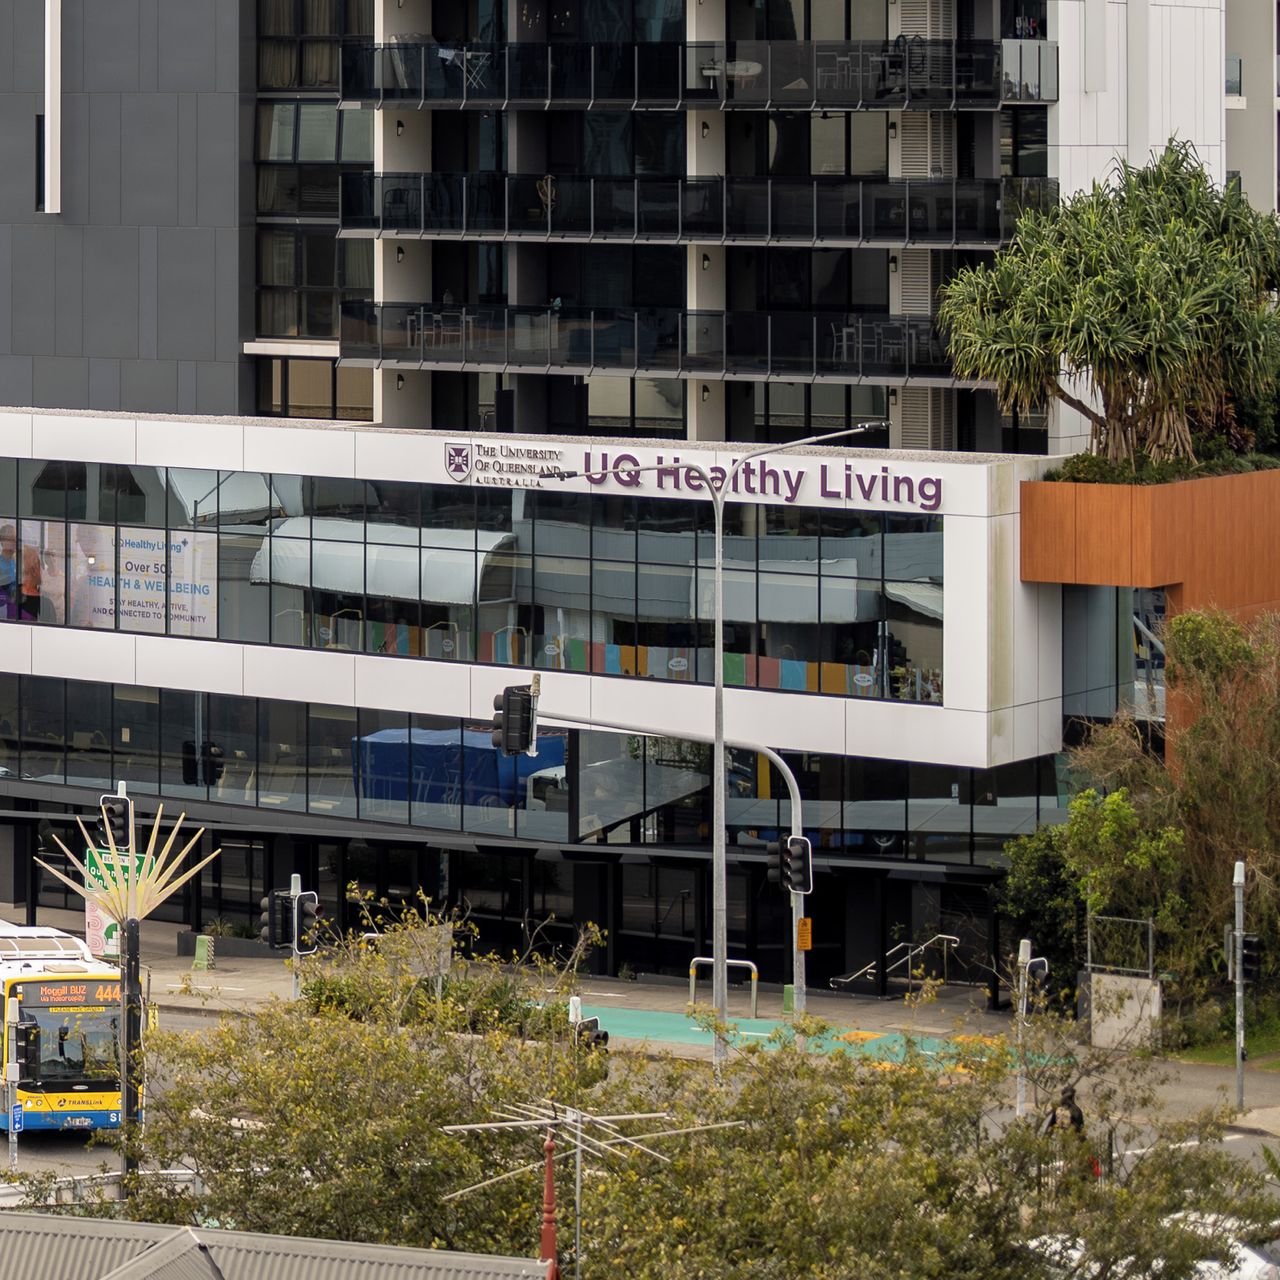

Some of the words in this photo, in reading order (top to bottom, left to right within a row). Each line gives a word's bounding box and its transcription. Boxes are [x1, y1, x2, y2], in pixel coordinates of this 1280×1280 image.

[475, 476, 544, 488] AUSTRALIA
[584, 452, 642, 488] UQ
[656, 455, 805, 503] Healthy
[820, 463, 943, 511] Living
[125, 539, 156, 552] Healthy
[156, 541, 182, 553] Ling
[125, 561, 151, 573] Over
[88, 576, 132, 589] HEALH
[133, 581, 141, 590] &
[109, 598, 126, 607] SAY
[127, 599, 160, 610] HEALTHY,
[161, 603, 189, 612] ATIVE,
[92, 607, 107, 616] AND
[153, 611, 163, 620] TO
[164, 613, 207, 624] OMMUNITY
[70, 985, 87, 995] BUZ
[95, 984, 121, 1002] 444
